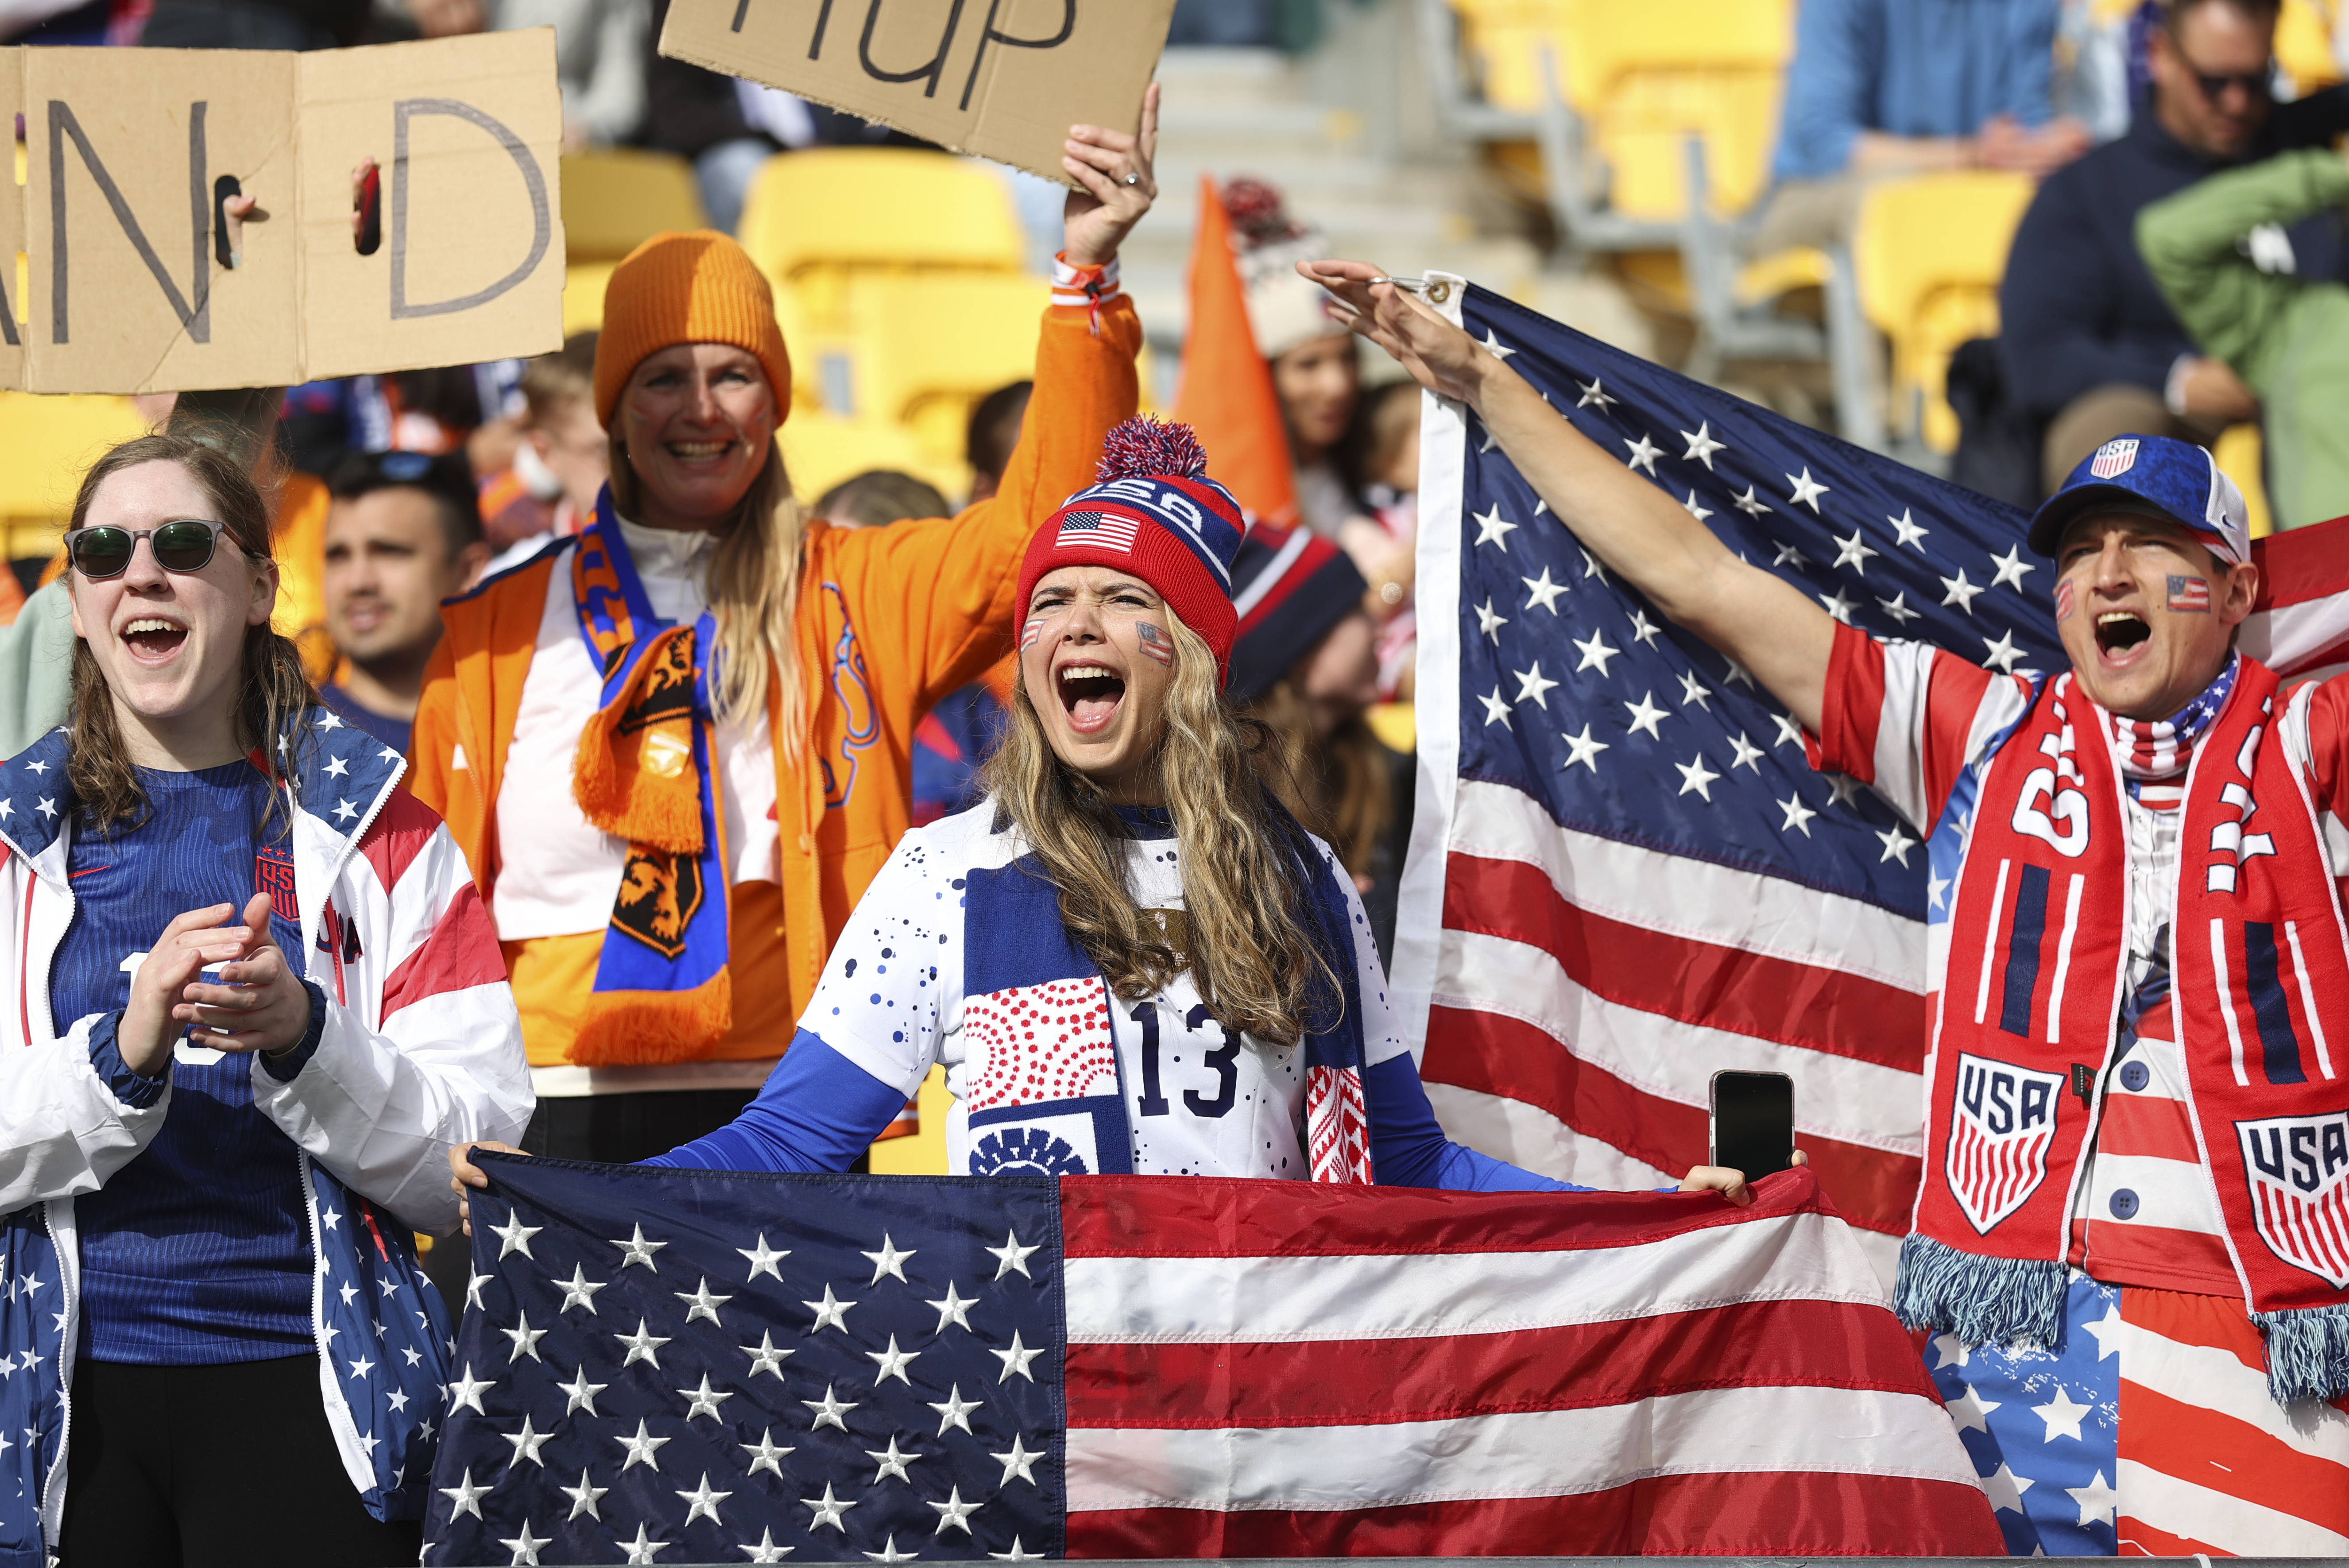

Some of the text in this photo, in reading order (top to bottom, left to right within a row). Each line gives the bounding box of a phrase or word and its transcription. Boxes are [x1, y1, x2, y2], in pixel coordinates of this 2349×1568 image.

[0, 98, 551, 345] ND
[263, 863, 294, 891] US
[1130, 1002, 1241, 1118] 13
[1963, 1065, 2052, 1134] USA
[2248, 1122, 2349, 1193] USA
